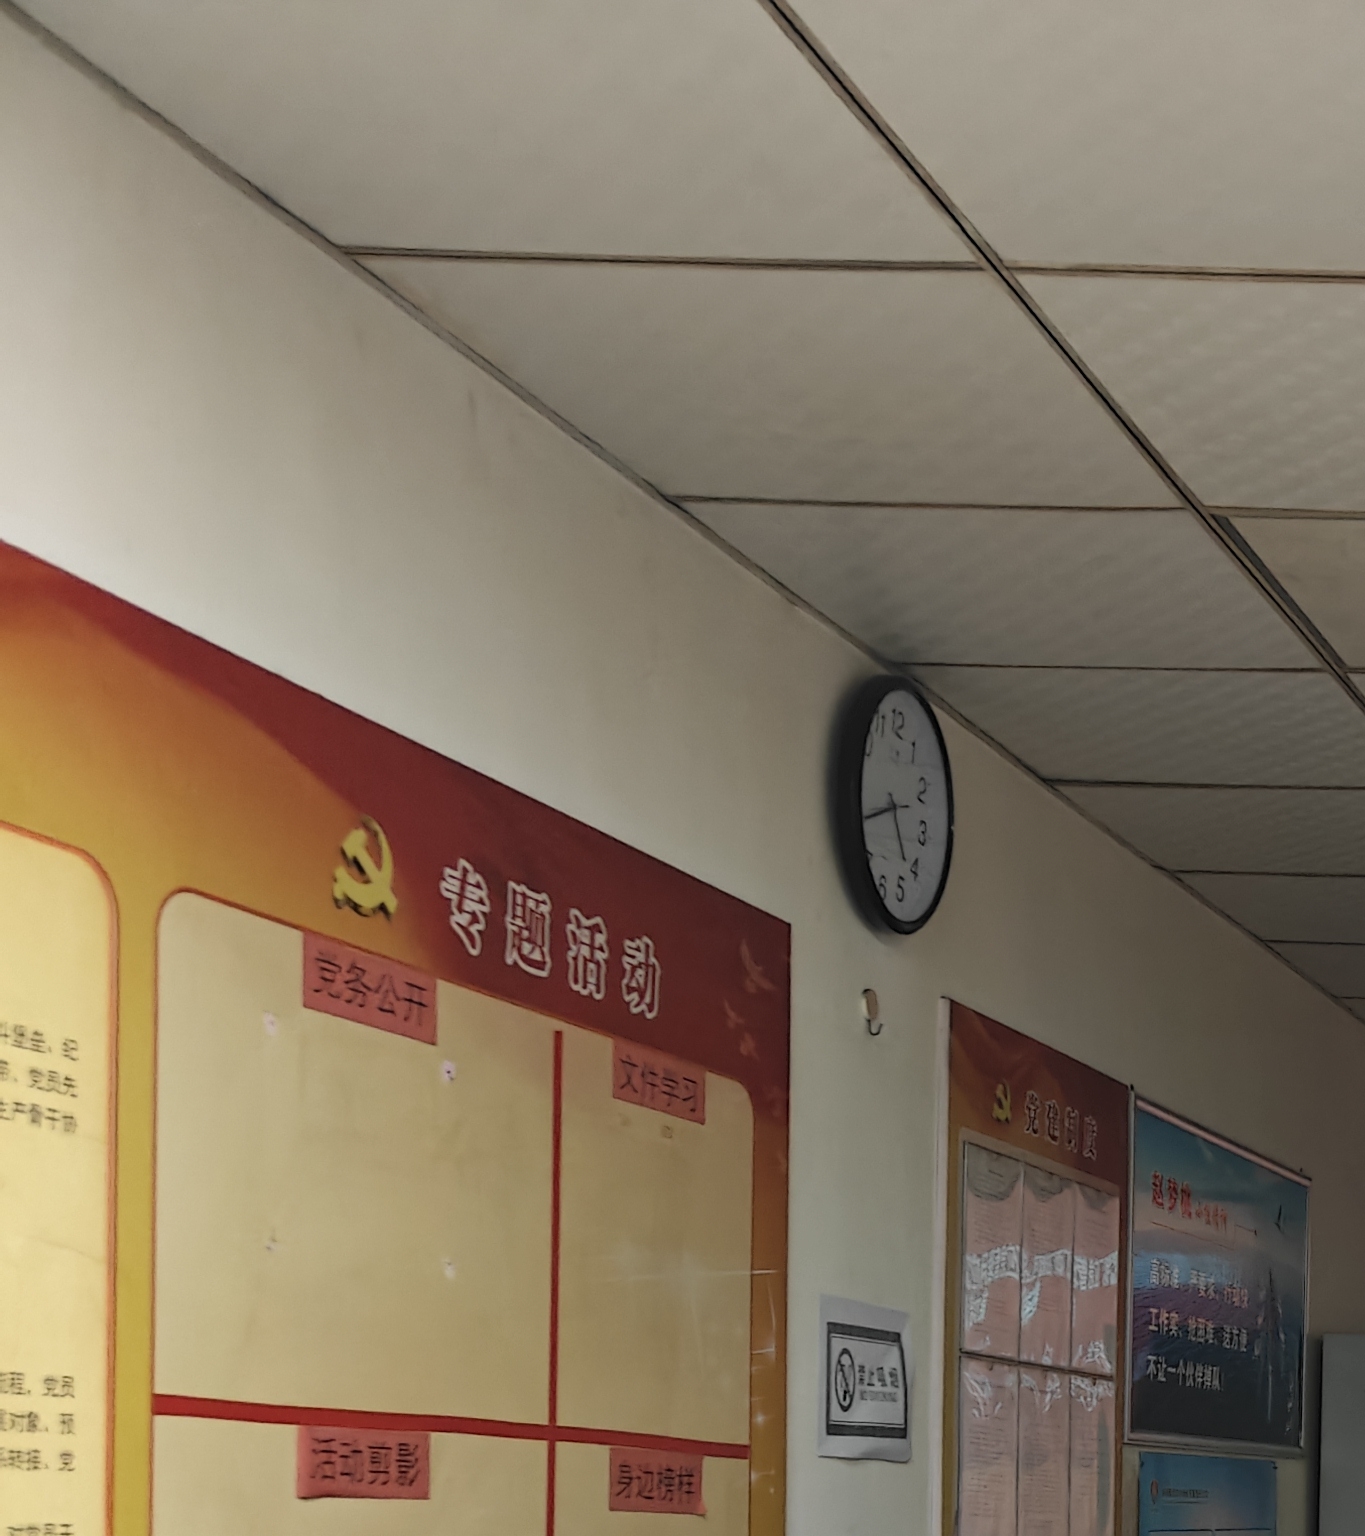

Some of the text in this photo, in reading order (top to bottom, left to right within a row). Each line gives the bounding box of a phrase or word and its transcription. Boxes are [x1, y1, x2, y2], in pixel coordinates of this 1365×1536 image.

[911, 742, 916, 764] 1
[917, 776, 927, 804] 2
[917, 819, 927, 847] 3
[910, 857, 919, 881] 4
[878, 875, 887, 901] 6
[895, 876, 905, 903] 5
[439, 857, 662, 1020] 专题活动
[312, 946, 430, 1029] 党务公开
[617, 1052, 700, 1117] 文件学习
[1023, 1090, 1098, 1161] 党建制度
[309, 1436, 422, 1489] 活动剪影
[615, 1460, 696, 1504] 身边榜样
